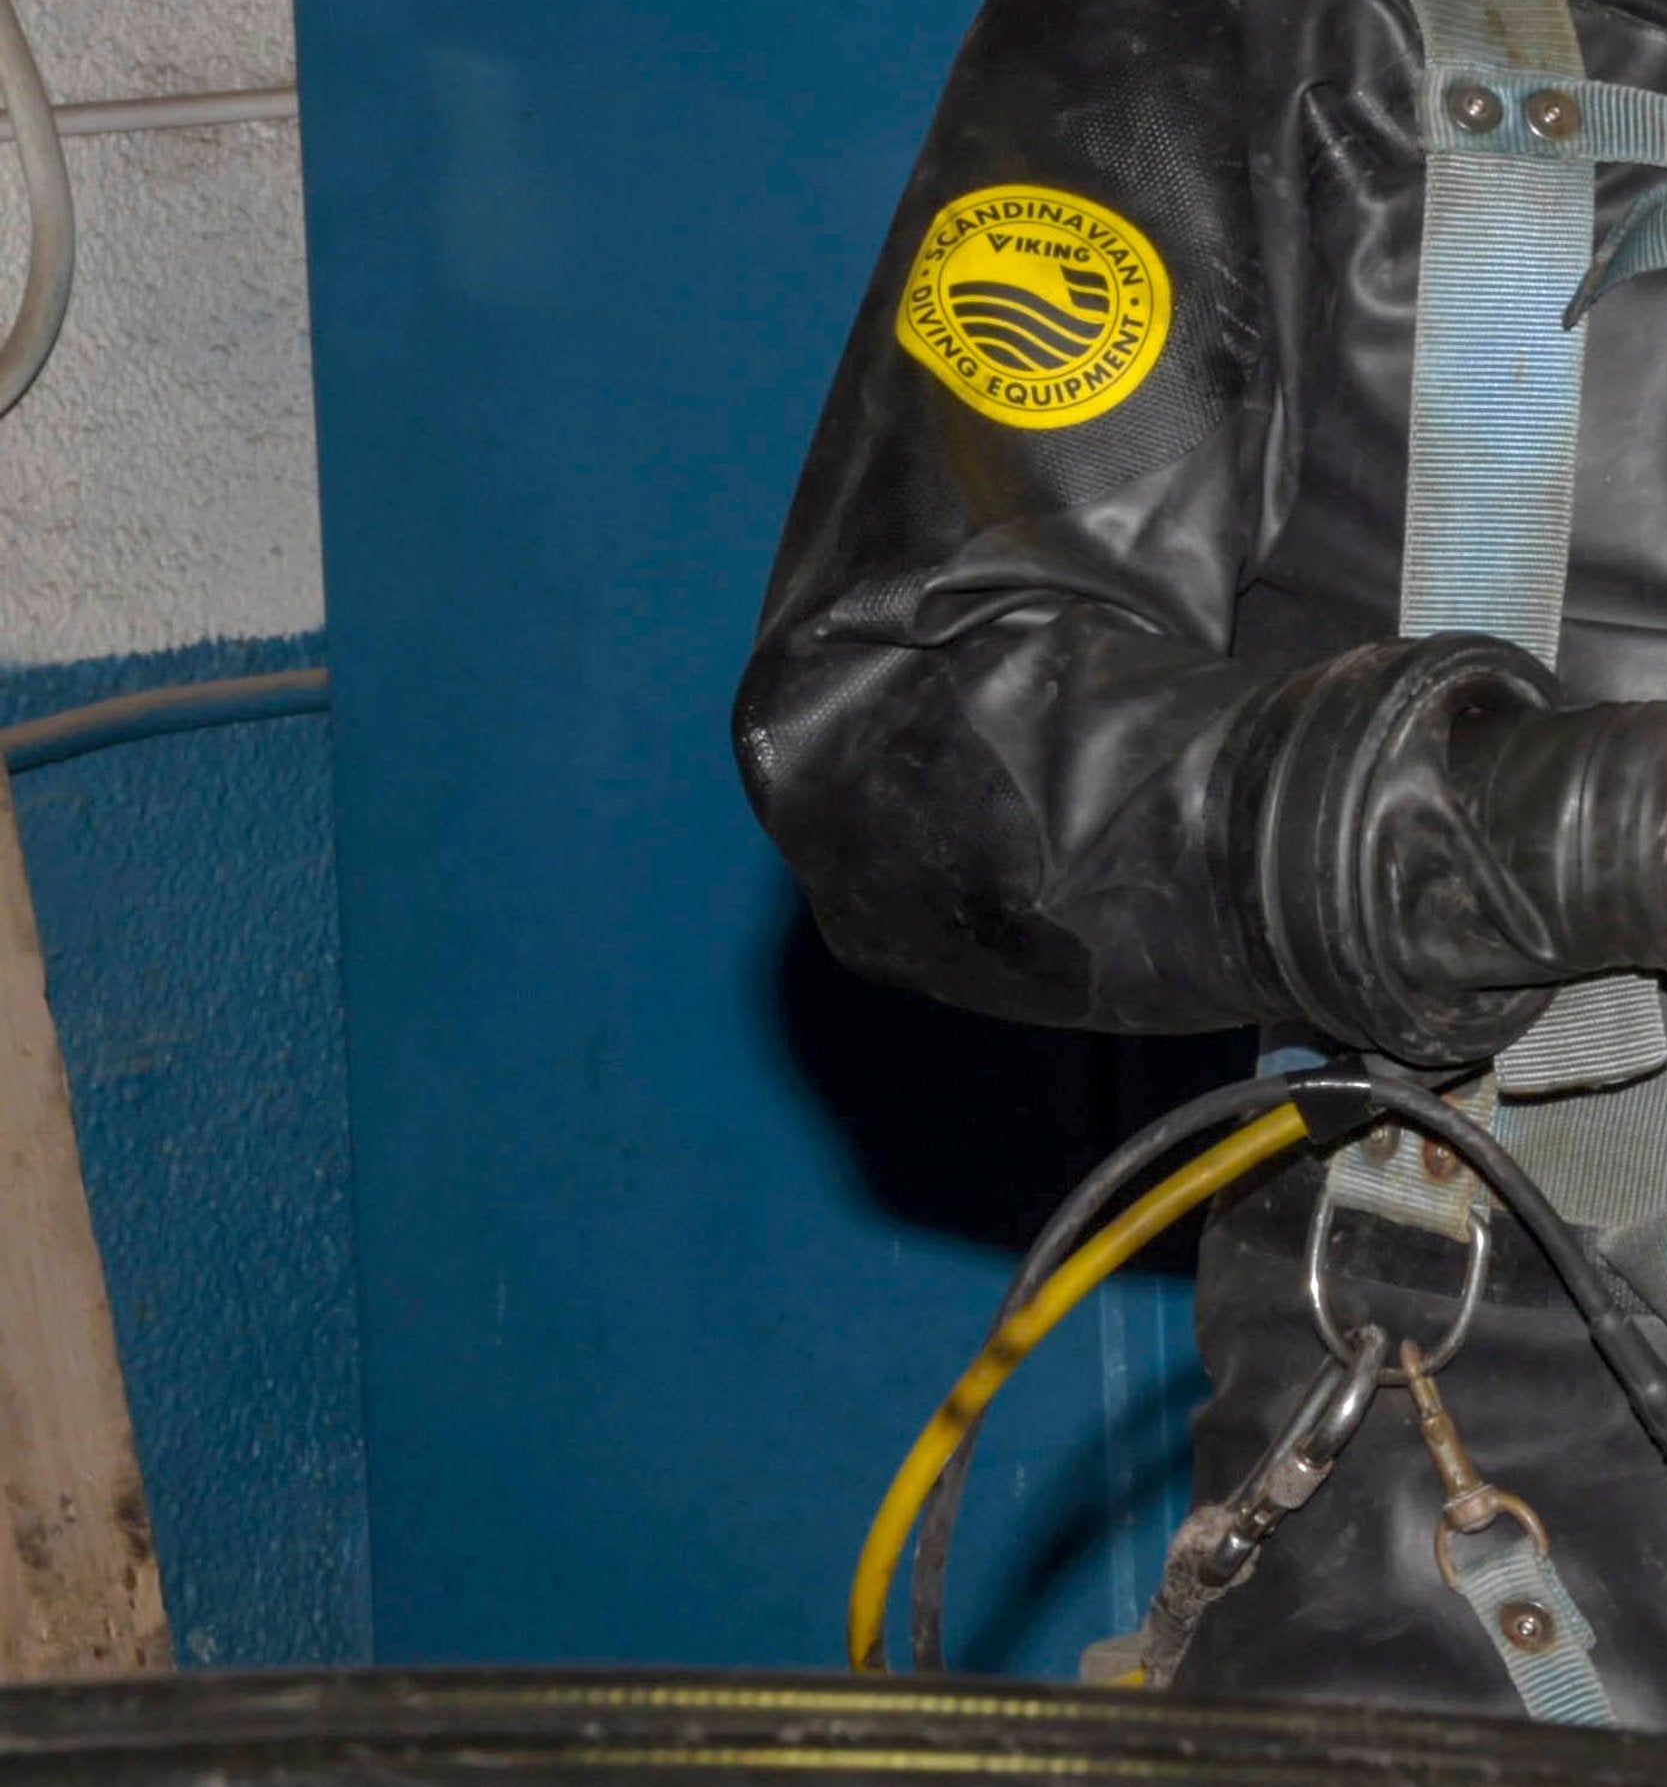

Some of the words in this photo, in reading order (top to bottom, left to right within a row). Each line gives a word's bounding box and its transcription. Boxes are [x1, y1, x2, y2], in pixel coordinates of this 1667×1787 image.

[926, 201, 1144, 286] SCANDINAVIAN
[986, 233, 1091, 262] VIKING
[912, 285, 978, 378] DIVING
[986, 313, 1144, 406] EQUIPMENT
